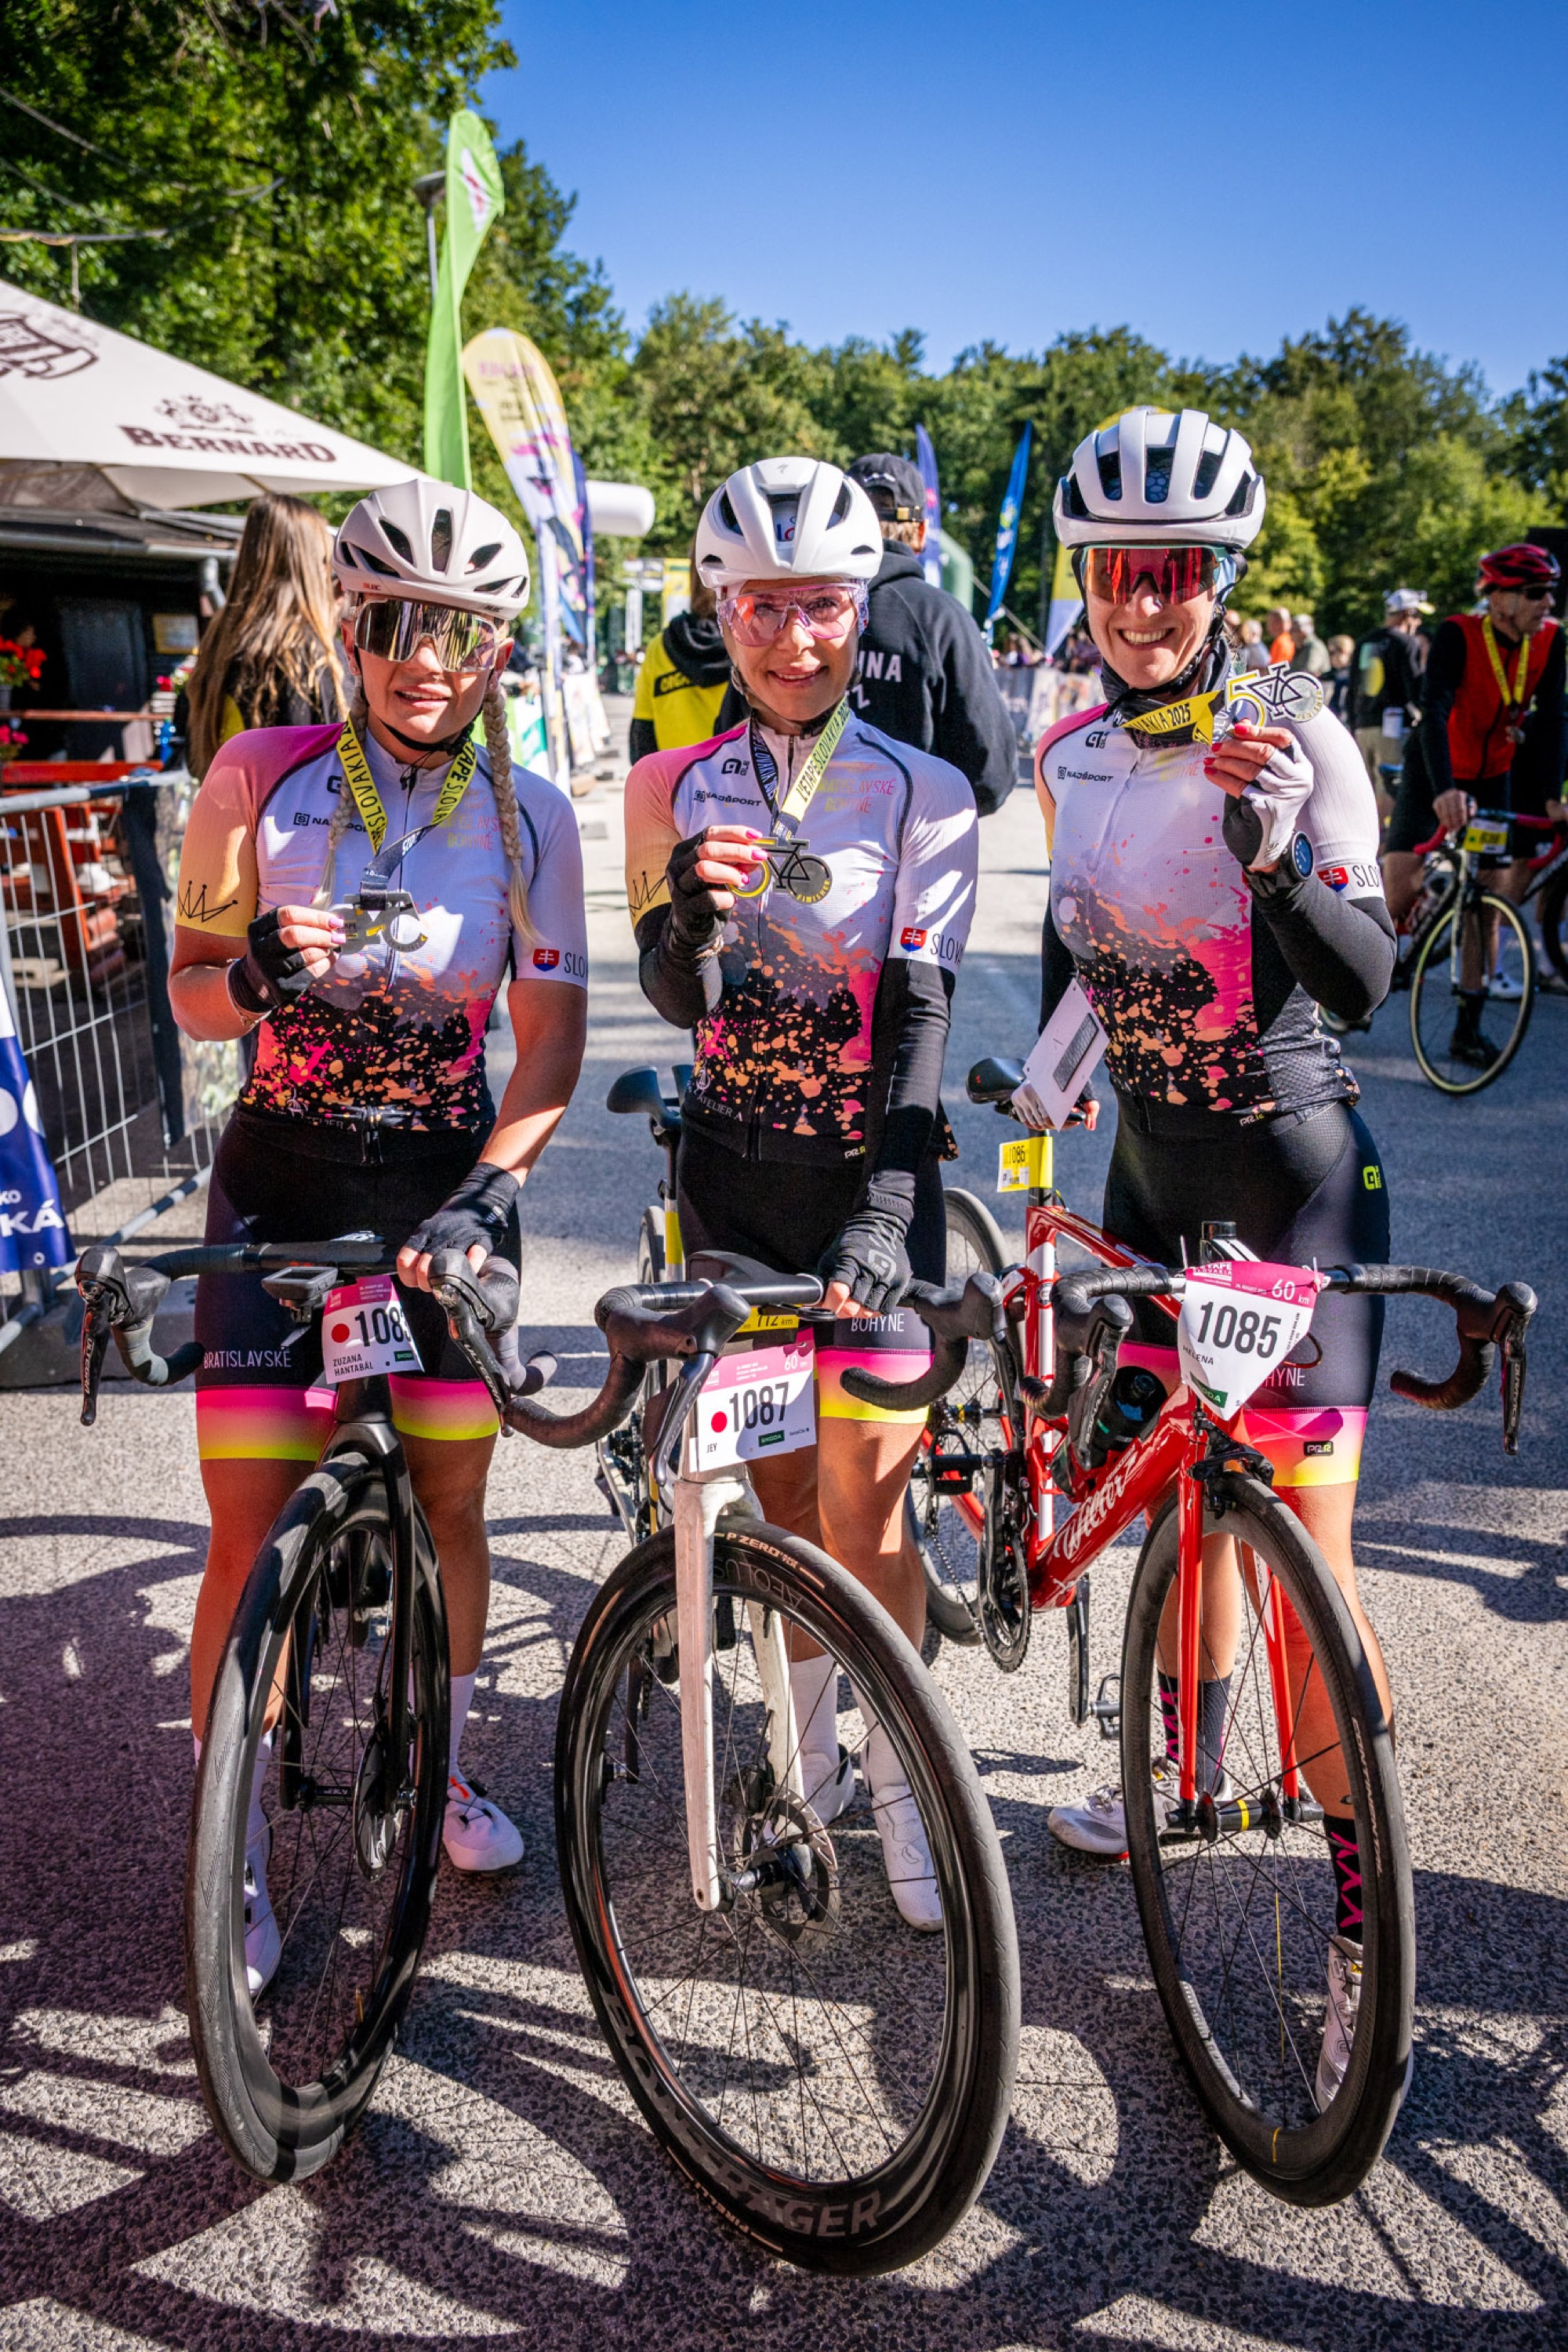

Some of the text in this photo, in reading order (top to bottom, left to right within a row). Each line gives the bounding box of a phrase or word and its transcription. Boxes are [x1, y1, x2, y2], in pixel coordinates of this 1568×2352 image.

[118, 425, 337, 463] BERNARD
[1167, 702, 1192, 728] 2025
[812, 716, 842, 770] SLOVAKIA
[340, 738, 387, 829] SLOVAKIA
[817, 778, 897, 795] RATISLAVSKÉ
[1066, 770, 1113, 782] NAJŠPORT
[432, 782, 464, 823] SLOVA
[796, 878, 831, 903] FINISHER
[697, 1095, 743, 1122] ATELIER A
[1271, 1279, 1310, 1305] 60 km
[851, 1313, 906, 1333] BOHYNE
[1197, 1301, 1282, 1359] 1085
[204, 1348, 292, 1370] BRATISLAVSKÉ
[332, 1353, 363, 1367] ZUZANA
[784, 1355, 797, 1371] 60
[1182, 1345, 1214, 1366] HELENA
[334, 1361, 374, 1377] HANTABÁL
[1265, 1367, 1305, 1388] HYNE
[728, 1381, 789, 1433] 1087
[706, 1443, 717, 1454] JEY
[726, 1531, 781, 1558] P ZERO
[601, 1991, 881, 2238] BONTRAGER
